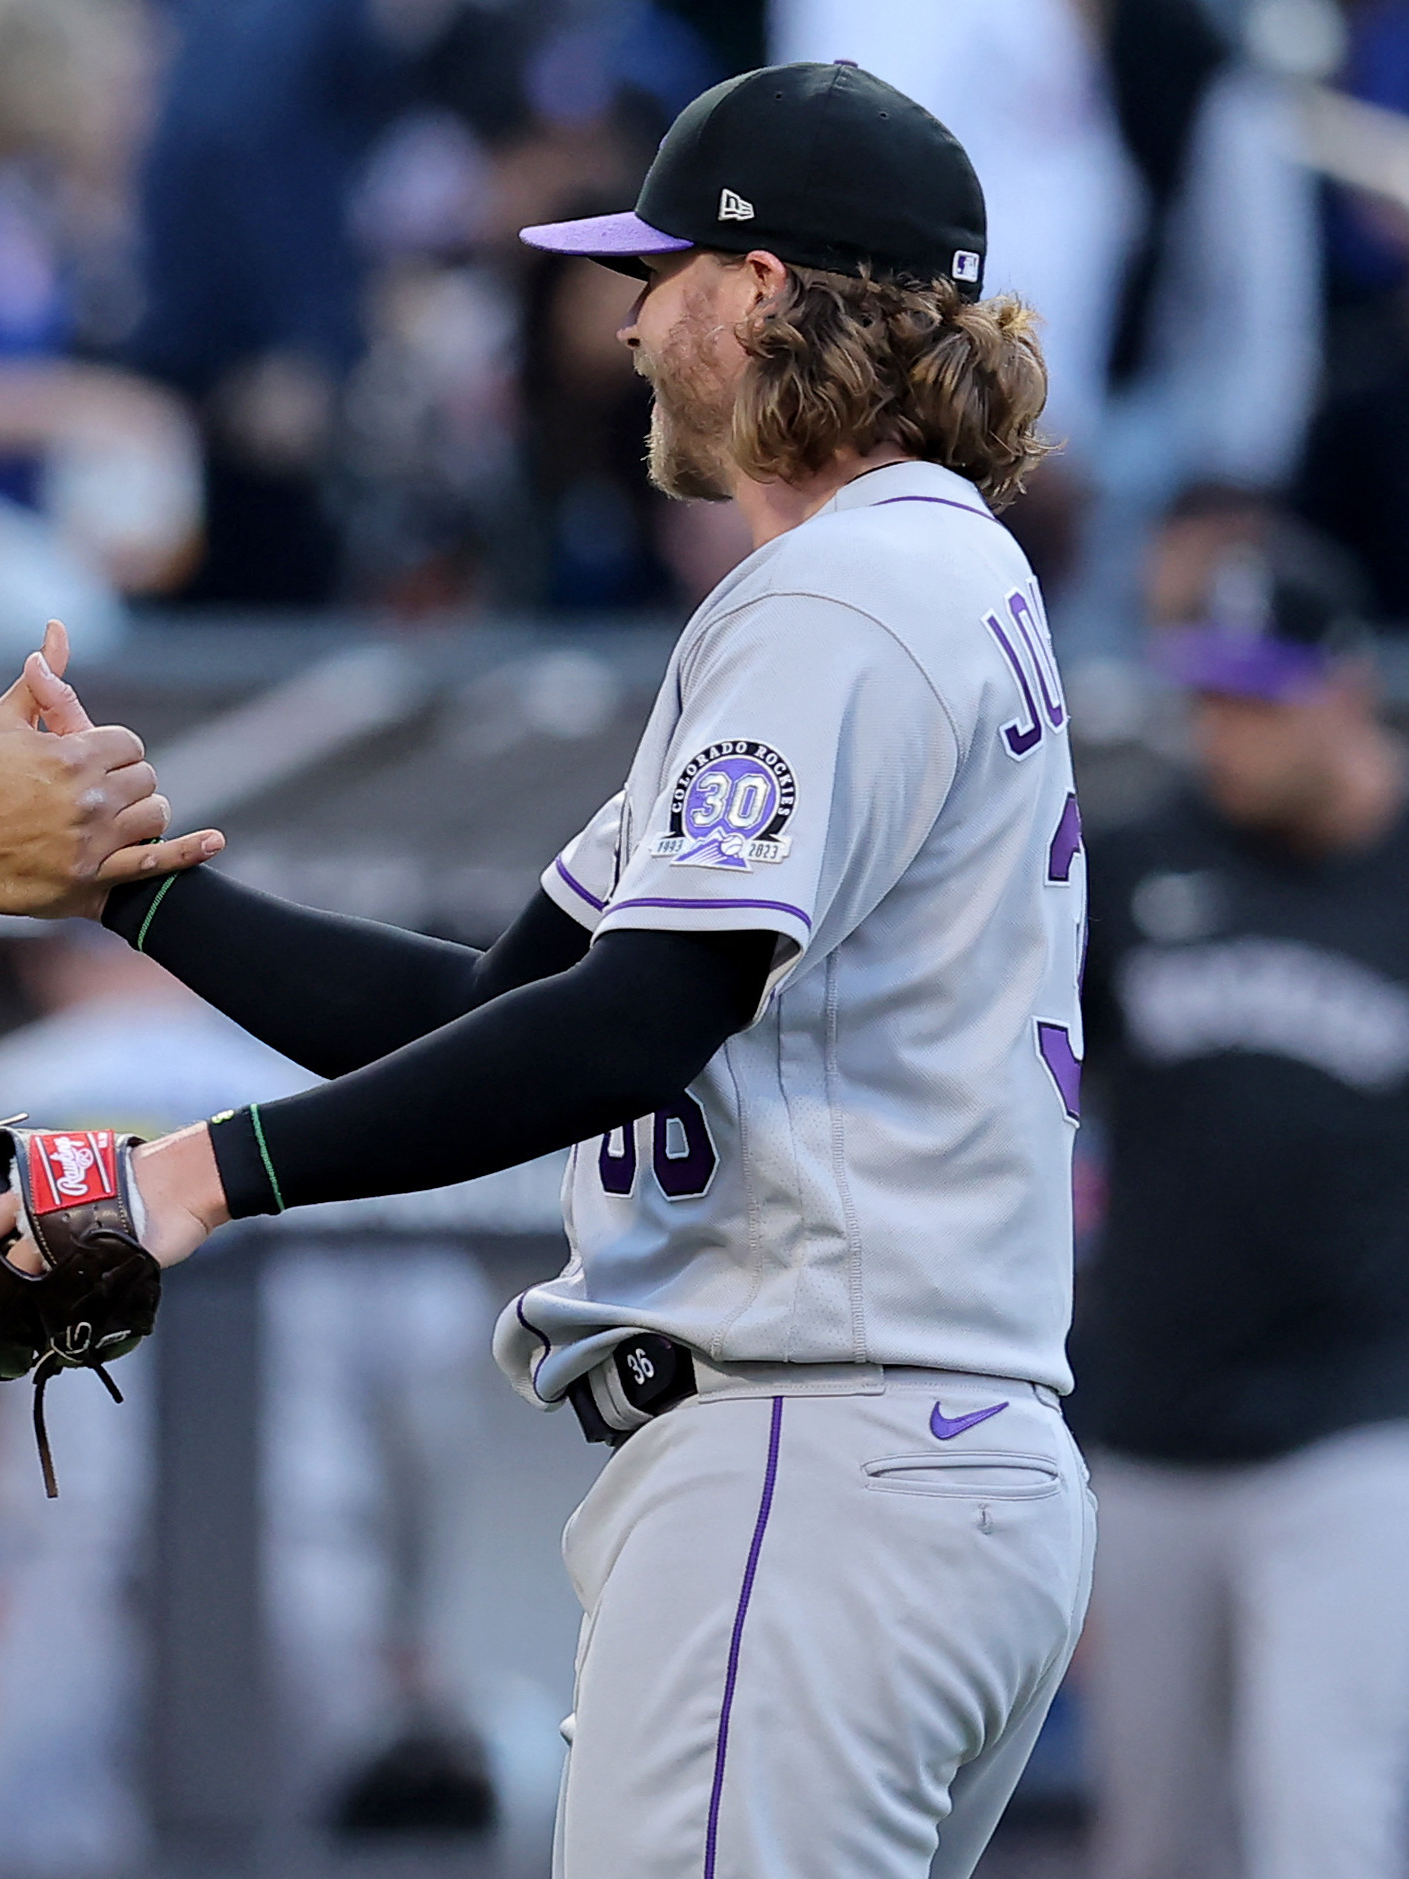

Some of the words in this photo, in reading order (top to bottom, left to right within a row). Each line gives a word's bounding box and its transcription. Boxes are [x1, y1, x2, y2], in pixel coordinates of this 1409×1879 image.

[672, 741, 748, 814] COLORADO
[754, 744, 795, 817] ROCKIES
[690, 771, 771, 829] 30
[657, 839, 685, 854] 1993
[748, 842, 779, 860] 2023
[626, 1348, 655, 1385] 36
